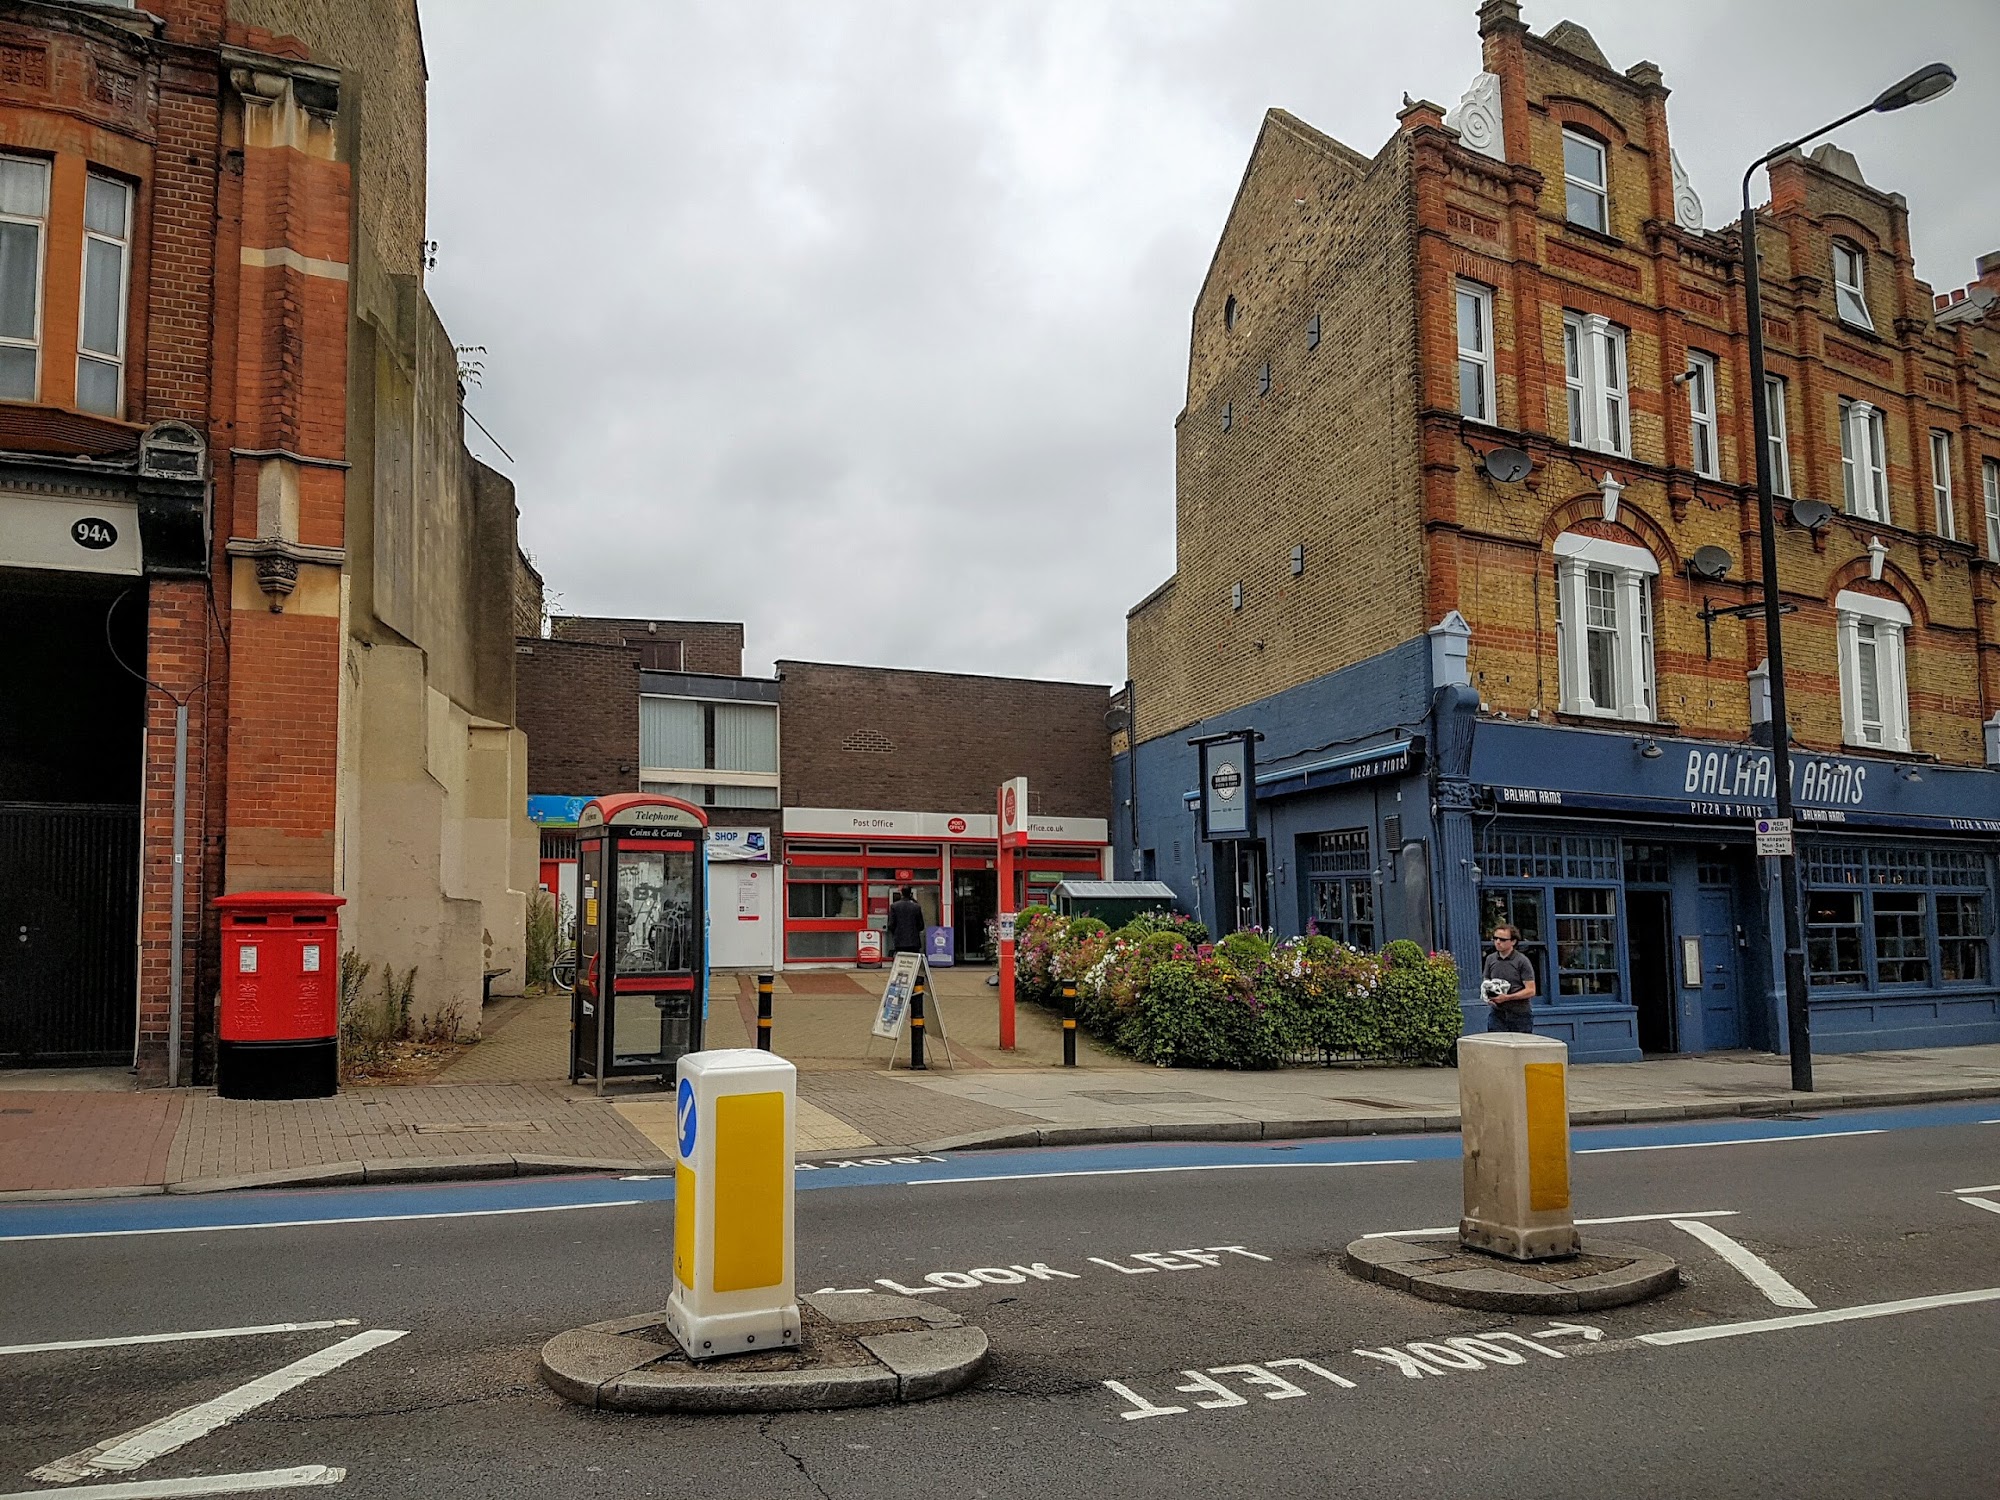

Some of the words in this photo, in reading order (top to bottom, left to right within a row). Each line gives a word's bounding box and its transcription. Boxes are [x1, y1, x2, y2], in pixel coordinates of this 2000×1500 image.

[77, 523, 111, 542] 94A
[1350, 764, 1371, 780] PIZZA
[1374, 762, 1378, 775] &
[1382, 757, 1405, 773] PINTS
[1684, 750, 1795, 799] BALHA
[1801, 761, 1866, 804] ARMS
[1503, 788, 1537, 803] BALHAM
[1539, 790, 1562, 804] ARMS
[635, 810, 679, 822] Telephone
[1691, 802, 1720, 815] PIZZA
[1725, 805, 1731, 815] &
[1736, 805, 1763, 818] PINTS
[1802, 809, 1828, 821] BALHAM
[1828, 811, 1846, 822] ARMS
[853, 818, 870, 827] Post
[872, 819, 894, 828] Office
[1950, 819, 1974, 830] PIZZA
[629, 828, 651, 837] Coins
[651, 829, 659, 837] &
[660, 829, 683, 838] Cards
[715, 832, 738, 841] SHOP
[824, 1155, 948, 1168] LOOK
[875, 1262, 1081, 1296] LOOK
[1087, 1245, 1273, 1274] LEFT
[1352, 1331, 1566, 1379] LOOK
[1103, 1357, 1358, 1421] LEFT
